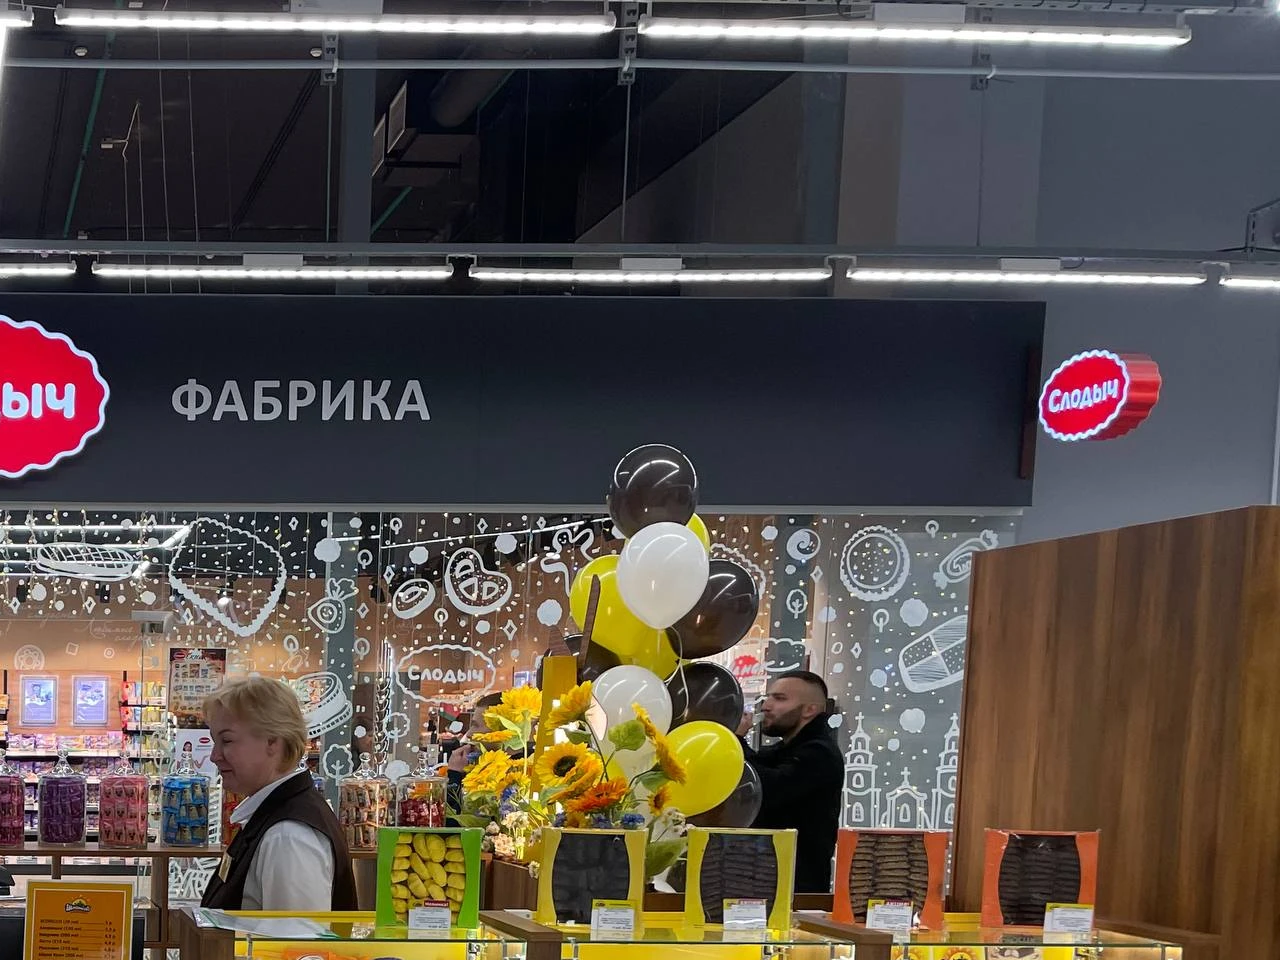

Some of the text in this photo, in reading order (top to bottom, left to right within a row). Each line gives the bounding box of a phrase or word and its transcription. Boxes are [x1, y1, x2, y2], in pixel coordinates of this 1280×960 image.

[171, 378, 430, 422] ФАБРИКА
[1048, 377, 1119, 414] Слодыч
[407, 664, 484, 684] Слодыч
